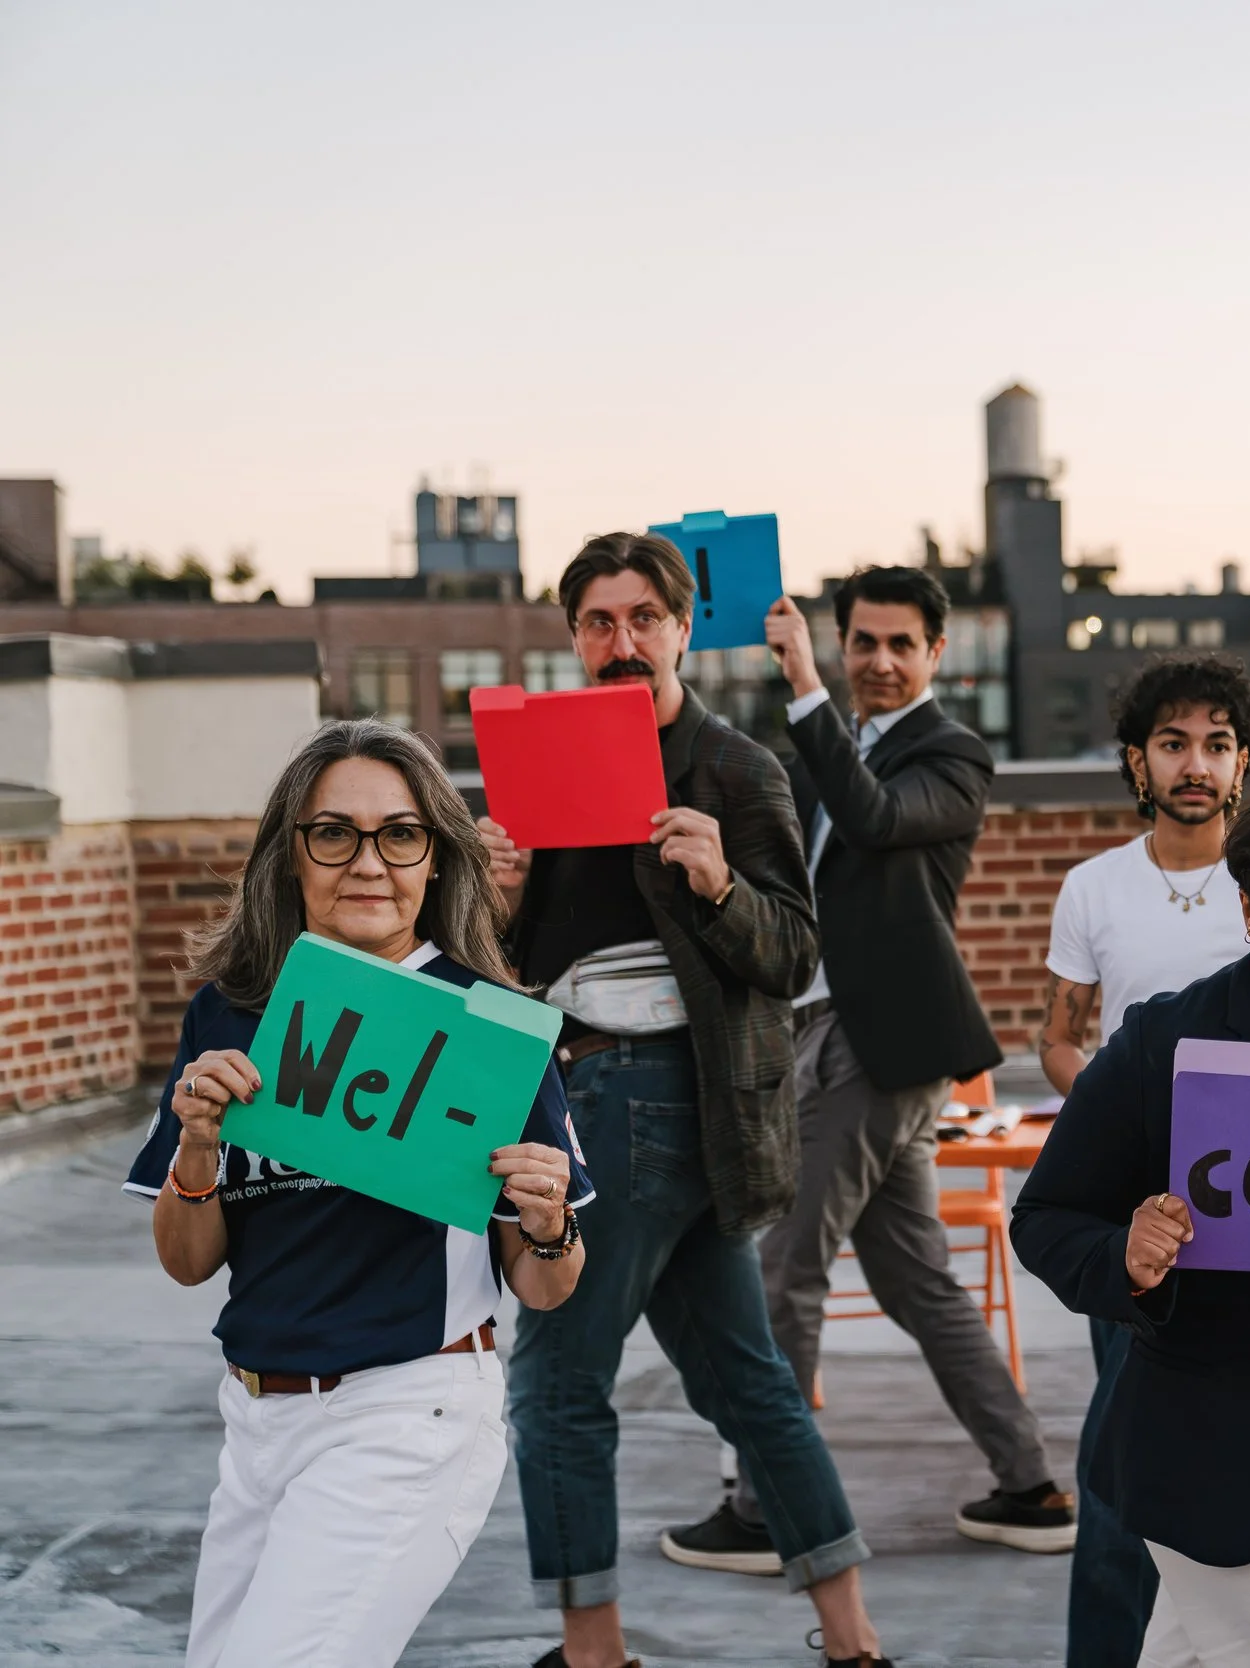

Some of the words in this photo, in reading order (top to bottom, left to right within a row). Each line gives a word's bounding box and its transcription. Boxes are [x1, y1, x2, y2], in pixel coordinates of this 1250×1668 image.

[695, 546, 713, 619] !
[274, 1000, 477, 1141] Wel-
[223, 1188, 244, 1202] ork
[245, 1184, 269, 1198] City
[270, 1177, 325, 1192] Emergency
